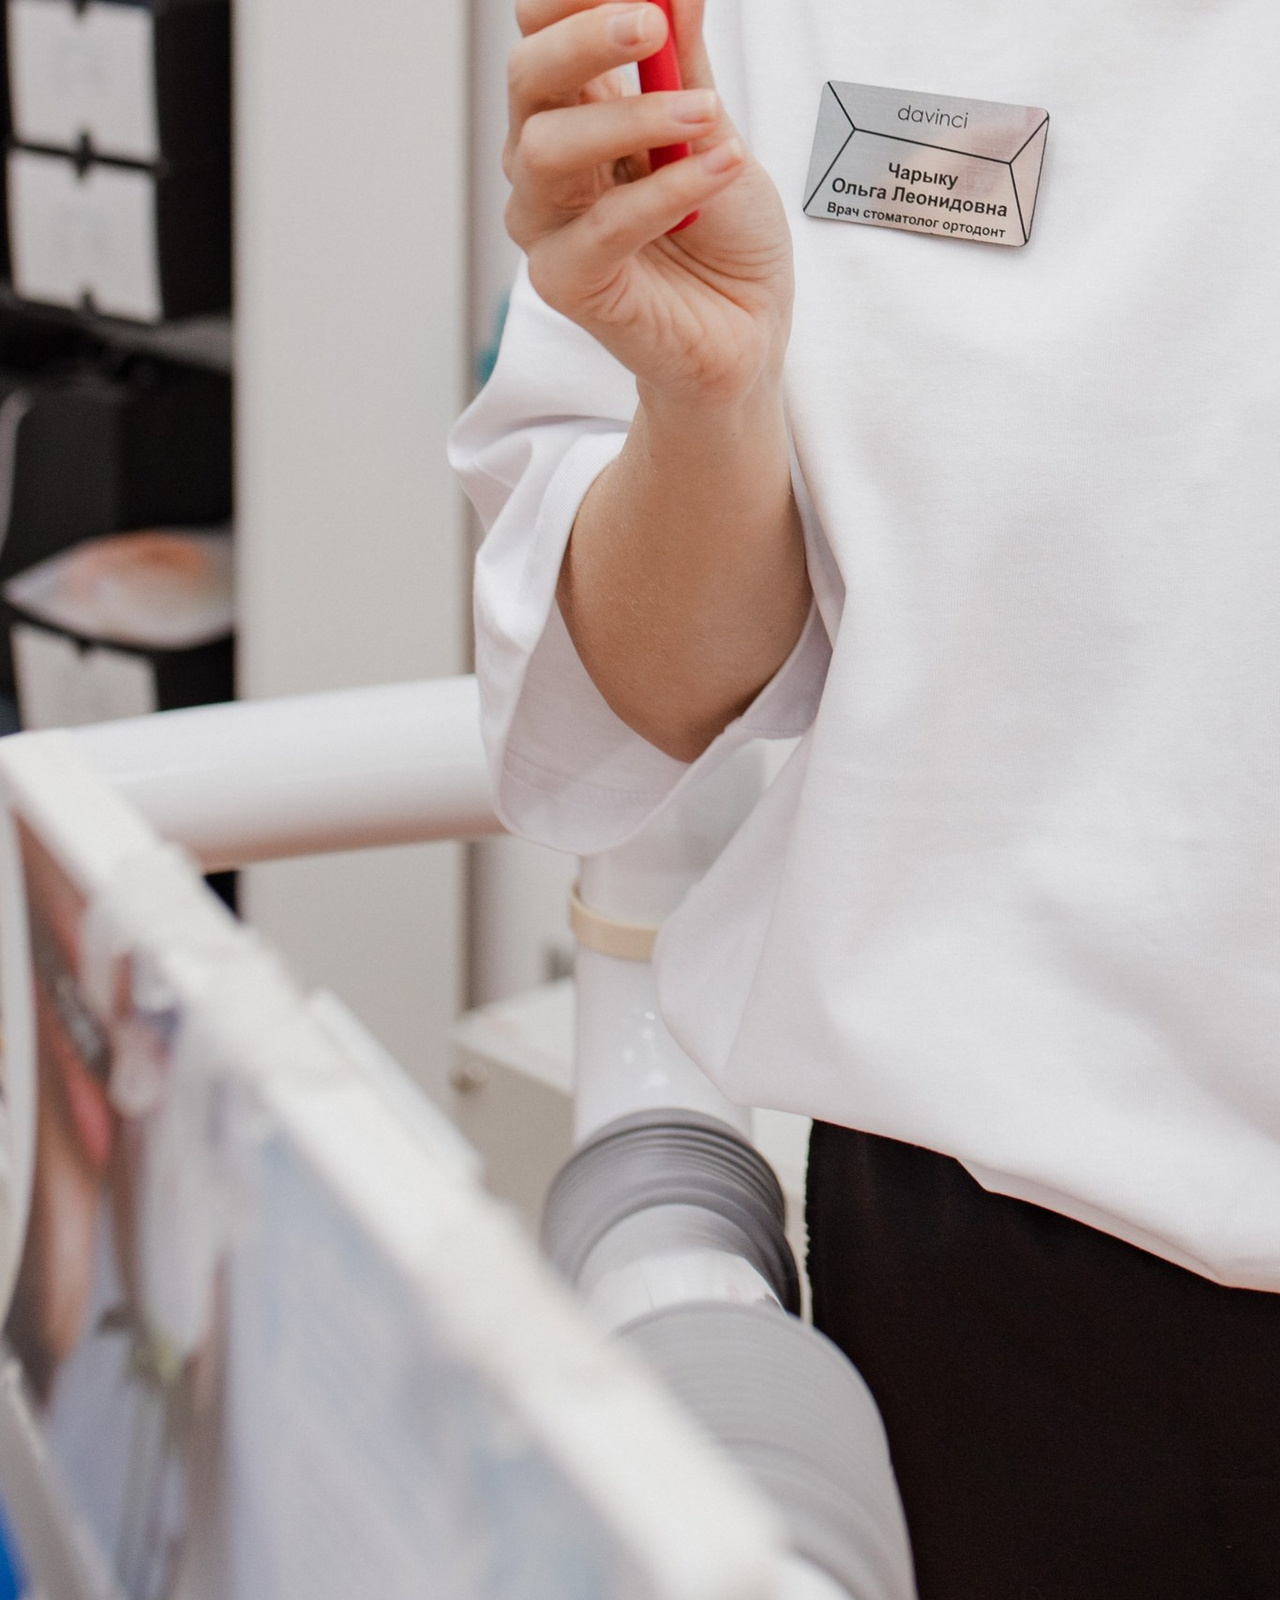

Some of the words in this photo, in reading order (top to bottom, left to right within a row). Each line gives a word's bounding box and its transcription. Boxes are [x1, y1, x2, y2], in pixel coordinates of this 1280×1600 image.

[897, 104, 969, 129] davinci
[888, 161, 959, 190] Чарыку
[831, 178, 887, 200] Ольга
[891, 186, 1008, 218] Леонидовна
[826, 201, 860, 218] Врач
[862, 209, 940, 230] стоматолог
[942, 220, 1006, 238] ортодонт
